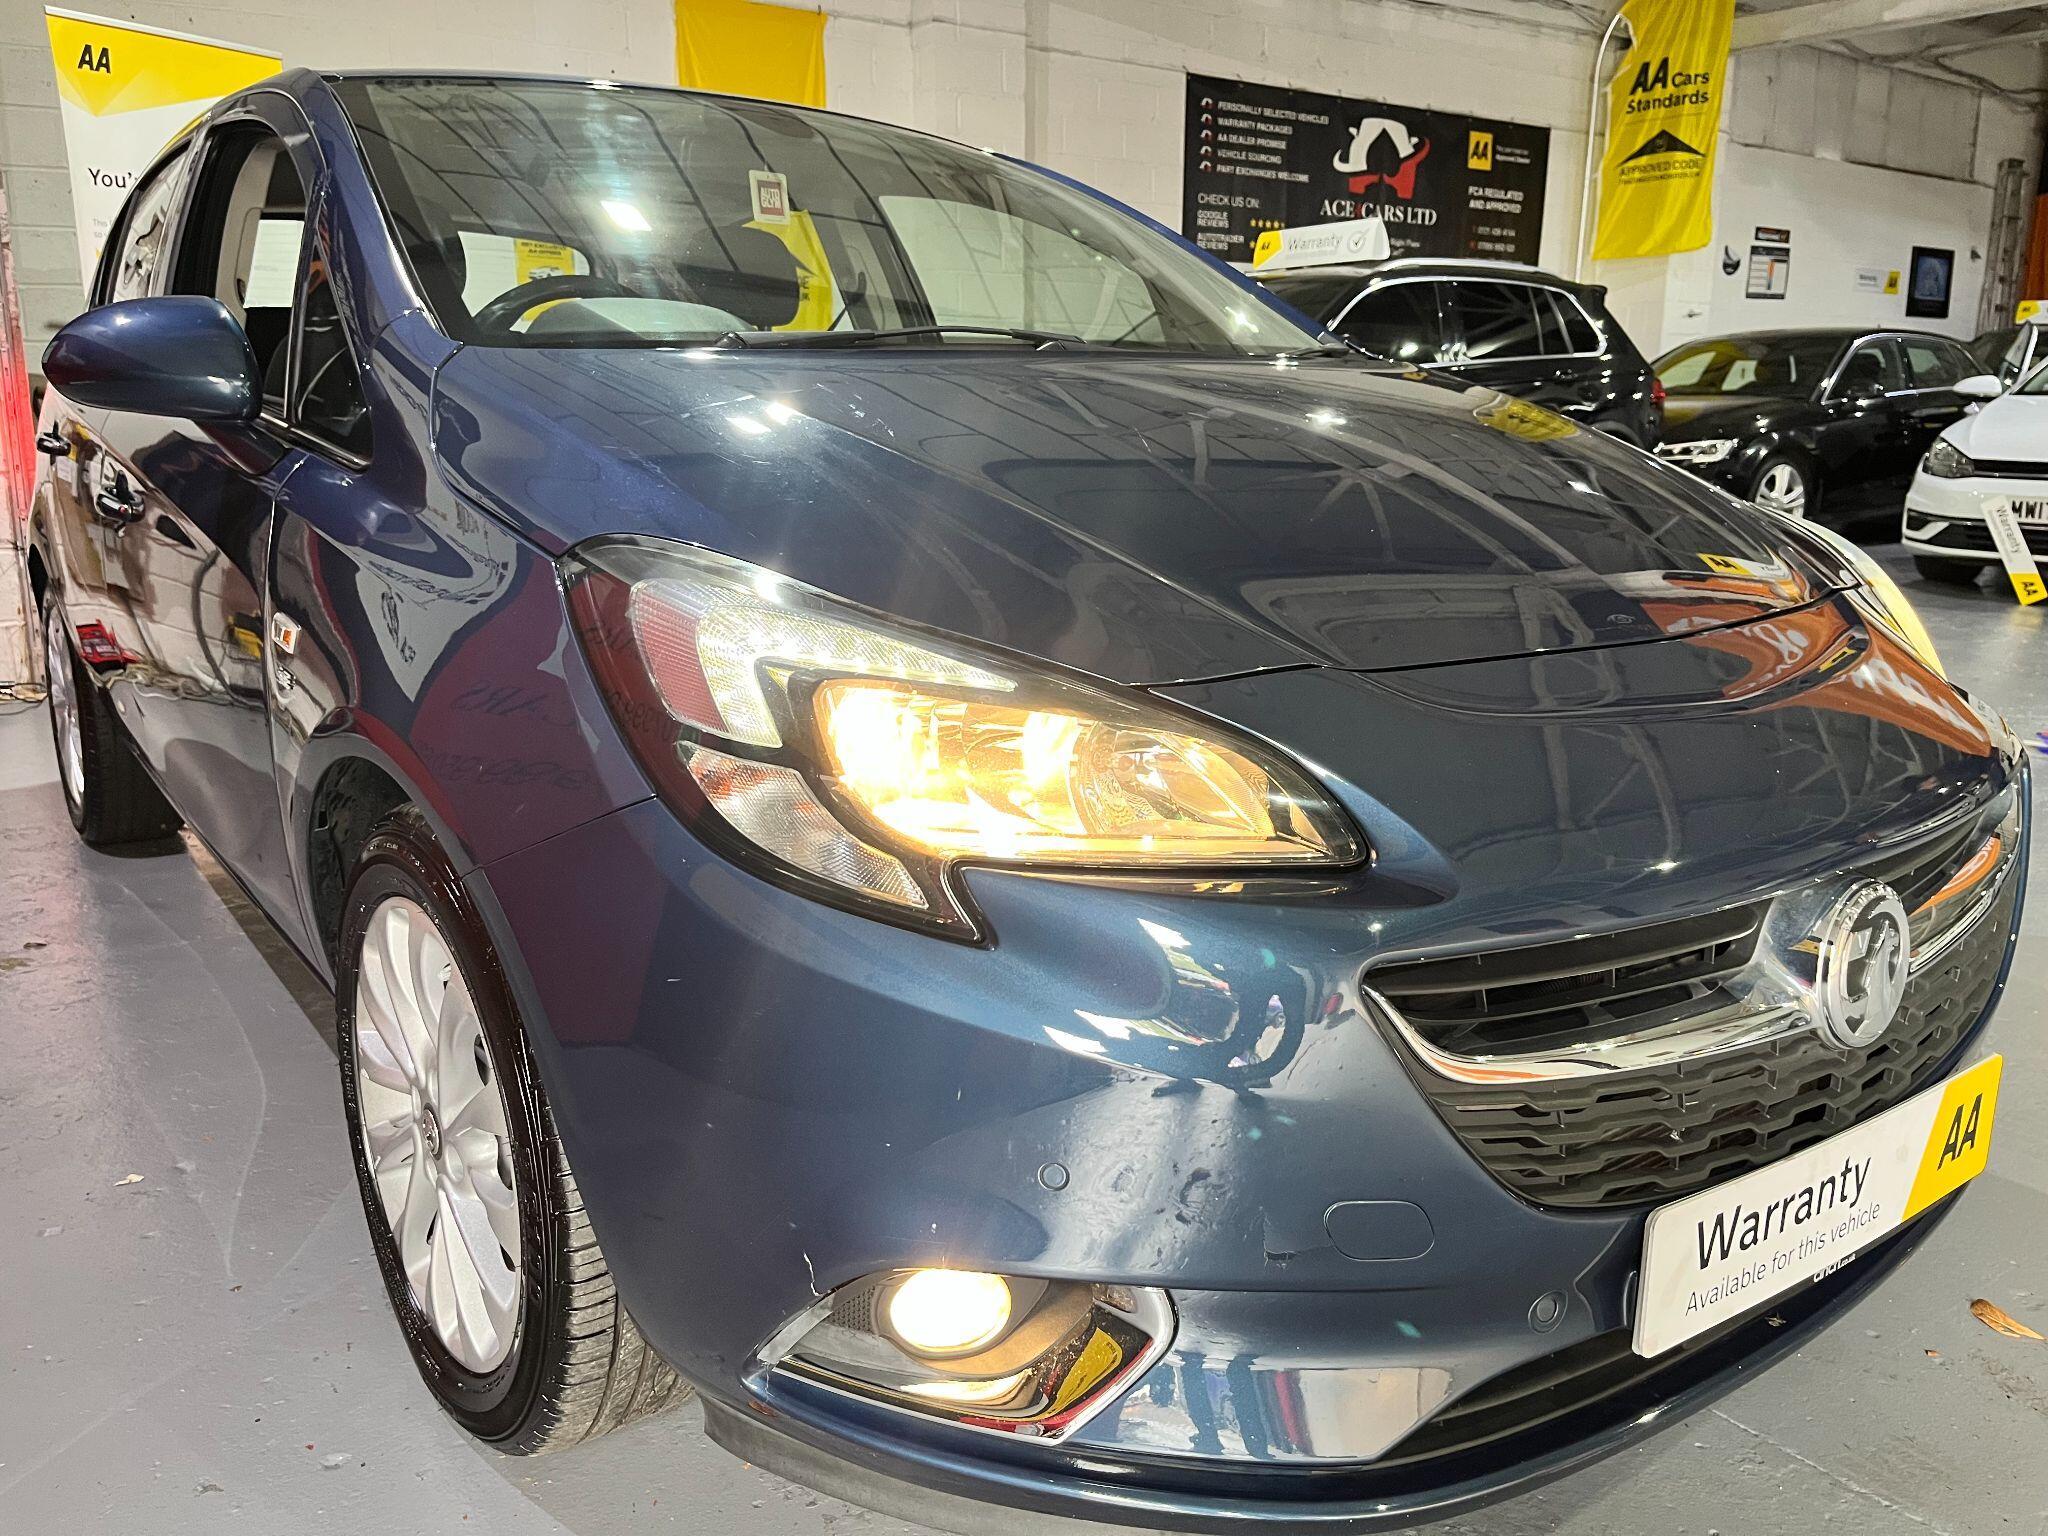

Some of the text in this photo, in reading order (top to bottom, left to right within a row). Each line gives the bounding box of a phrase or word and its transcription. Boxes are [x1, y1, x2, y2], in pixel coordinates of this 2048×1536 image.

[78, 44, 112, 74] AA
[1629, 56, 1710, 95] AA Cars
[1626, 90, 1709, 114] Standards
[1471, 141, 1489, 160] AA
[88, 167, 138, 188] You'
[760, 187, 780, 199] AUTO
[1197, 192, 1231, 206] CHECK
[1232, 196, 1244, 208] US
[1320, 198, 1437, 226] ACE CARS LTD
[2011, 499, 2048, 519] MW1
[2022, 581, 2039, 596] AA
[1697, 1093, 1984, 1271] Warranty AA
[1685, 1262, 1767, 1317] Available
[1771, 1249, 1795, 1271] for
[1799, 1230, 1826, 1261] this
[1830, 1201, 1881, 1243] vehicle
